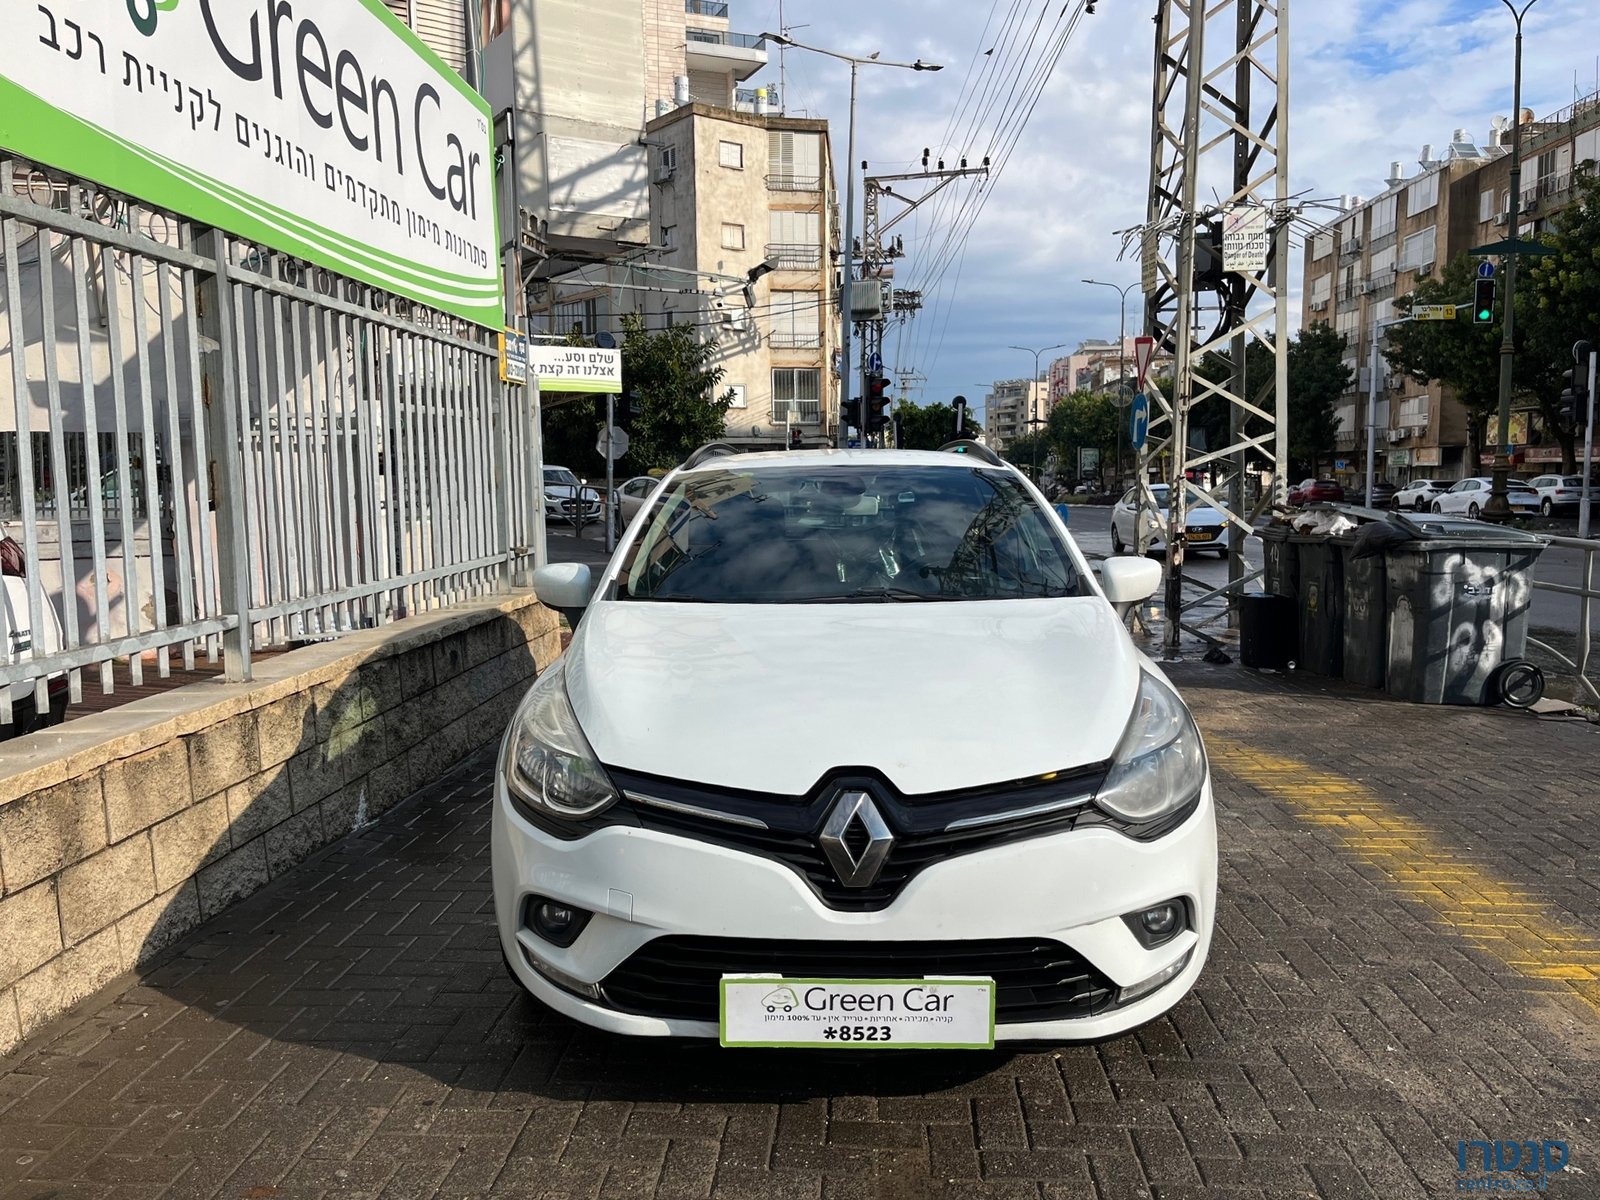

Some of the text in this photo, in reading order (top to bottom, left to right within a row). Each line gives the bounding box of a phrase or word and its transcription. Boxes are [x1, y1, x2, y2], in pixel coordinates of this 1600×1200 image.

[38, 4, 488, 269] פתרונות מימון מתקדמים והוגנים לקניית רכב
[414, 82, 481, 220] Car
[1245, 242, 1264, 250] סכנת
[1224, 252, 1241, 260] Danger
[1445, 308, 1453, 316] 13
[589, 352, 614, 364] שלם
[539, 363, 563, 377] קצת
[567, 365, 582, 375] זה
[584, 364, 615, 377] אצלנו
[804, 987, 954, 1012] Green Car
[763, 1014, 785, 1023] מימון
[828, 1015, 840, 1024] אין
[869, 1015, 898, 1023] אחריות
[935, 1015, 954, 1024] קניה
